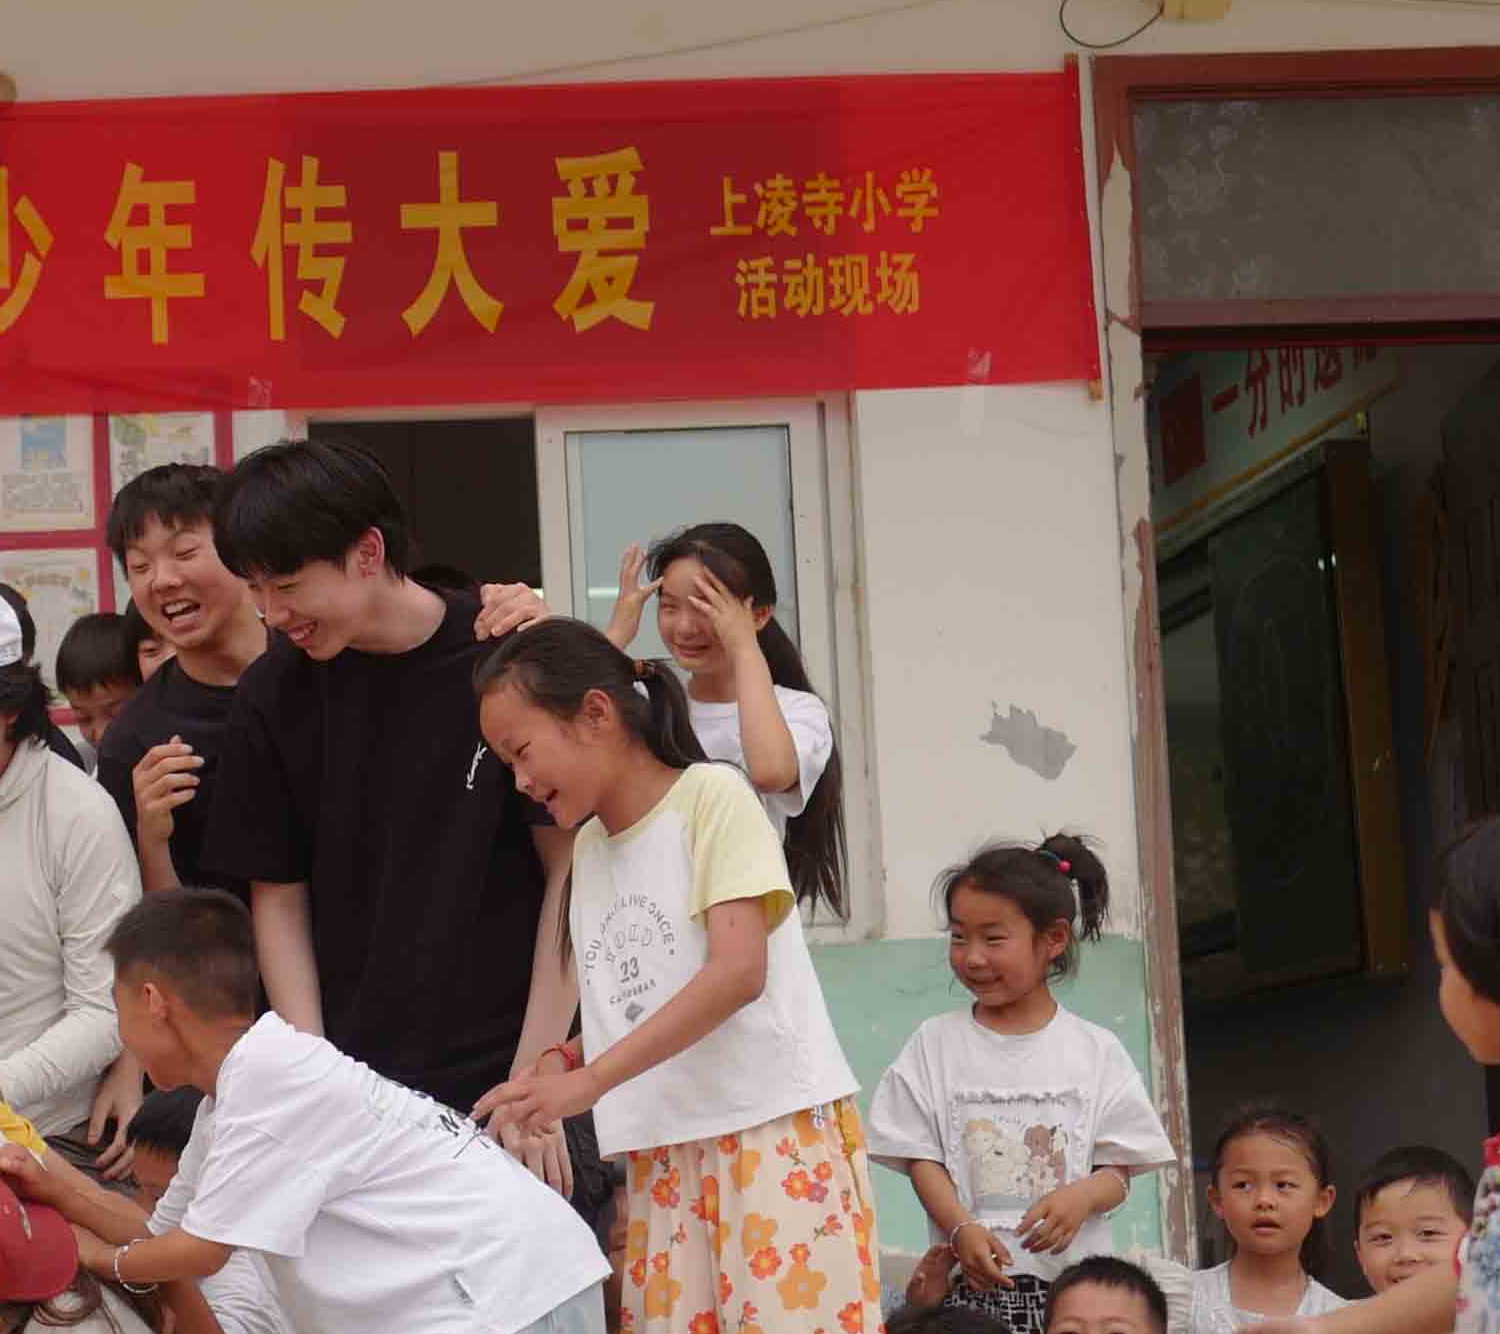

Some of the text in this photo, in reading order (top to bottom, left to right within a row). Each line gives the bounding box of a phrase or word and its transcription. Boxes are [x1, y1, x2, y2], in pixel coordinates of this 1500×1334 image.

[710, 169, 940, 236] 上凌寺小学
[735, 250, 921, 318] 活动现场
[621, 894, 648, 908] LIVE
[619, 956, 641, 984] 23
